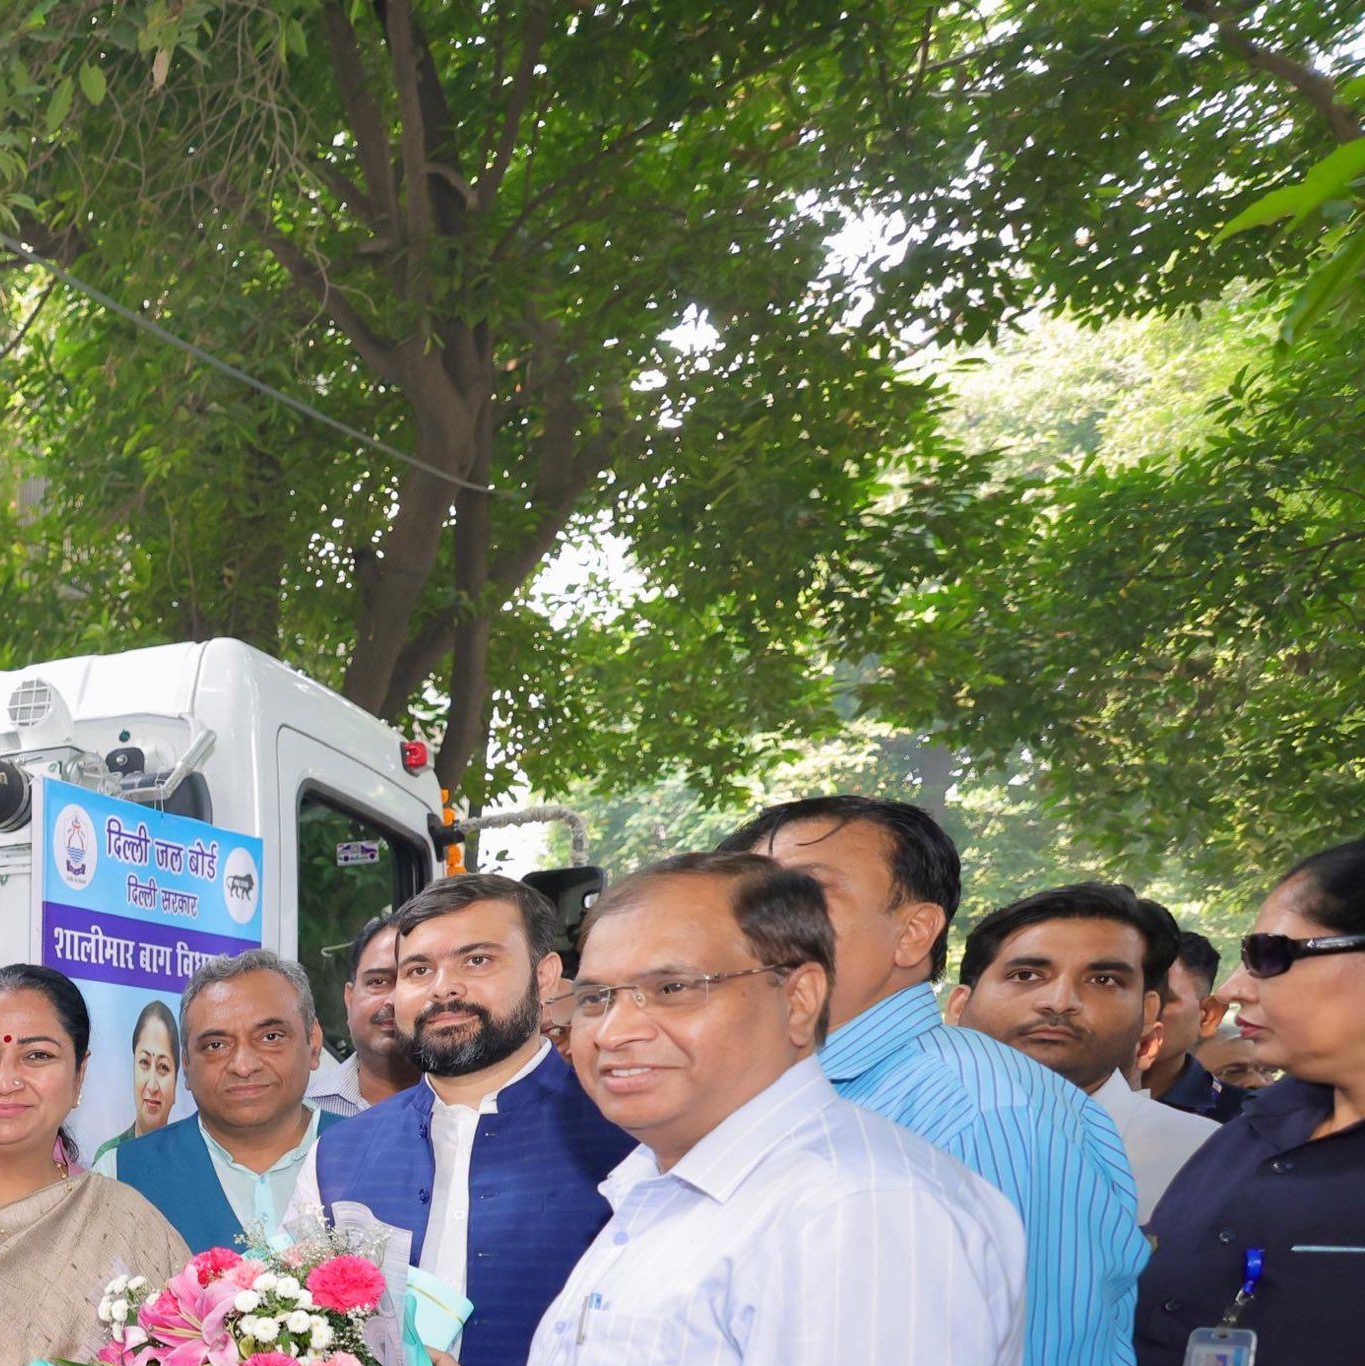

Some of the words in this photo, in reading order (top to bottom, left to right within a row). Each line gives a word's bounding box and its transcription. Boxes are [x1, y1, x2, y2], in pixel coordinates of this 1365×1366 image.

[106, 818, 151, 865] दिल्ली
[155, 841, 184, 873] जल
[188, 840, 217, 879] बोर्ड
[127, 875, 158, 908] दिल्ली
[161, 889, 198, 917] सरकार
[54, 925, 136, 970] शालीमार
[139, 941, 173, 976] बाग
